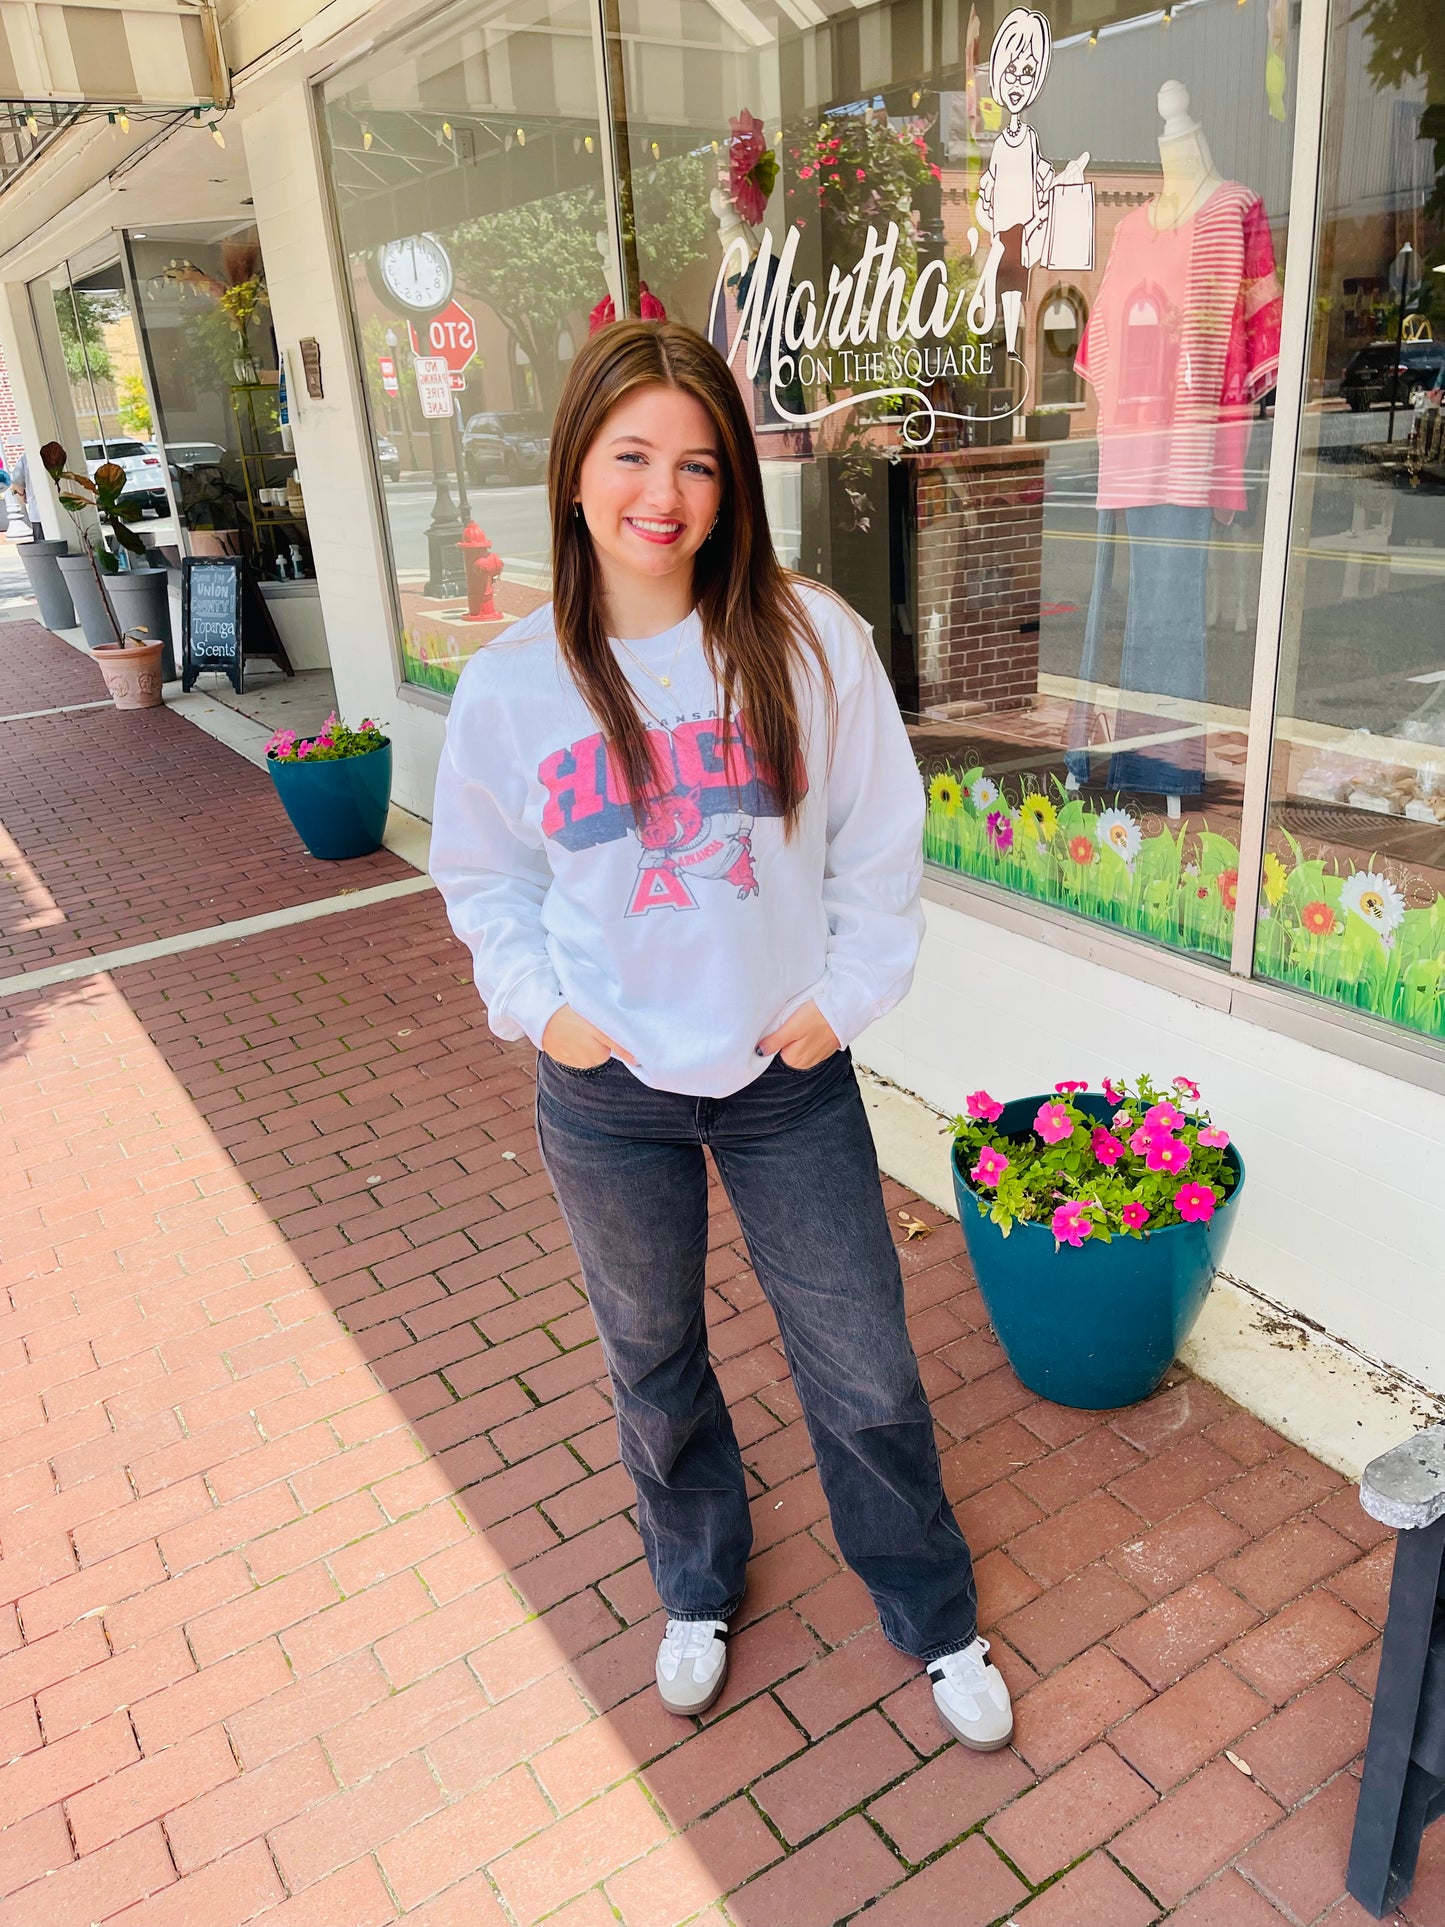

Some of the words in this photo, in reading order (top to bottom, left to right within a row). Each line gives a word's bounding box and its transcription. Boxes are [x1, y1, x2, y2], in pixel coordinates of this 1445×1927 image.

[707, 220, 1005, 387] Martha's
[798, 354, 832, 387] ON
[838, 349, 884, 384] THE
[890, 342, 995, 388] SQUARE
[193, 617, 235, 642] Topanga
[194, 641, 236, 657] Scents
[678, 838, 724, 867] ARKANSAS
[624, 868, 701, 918] A
